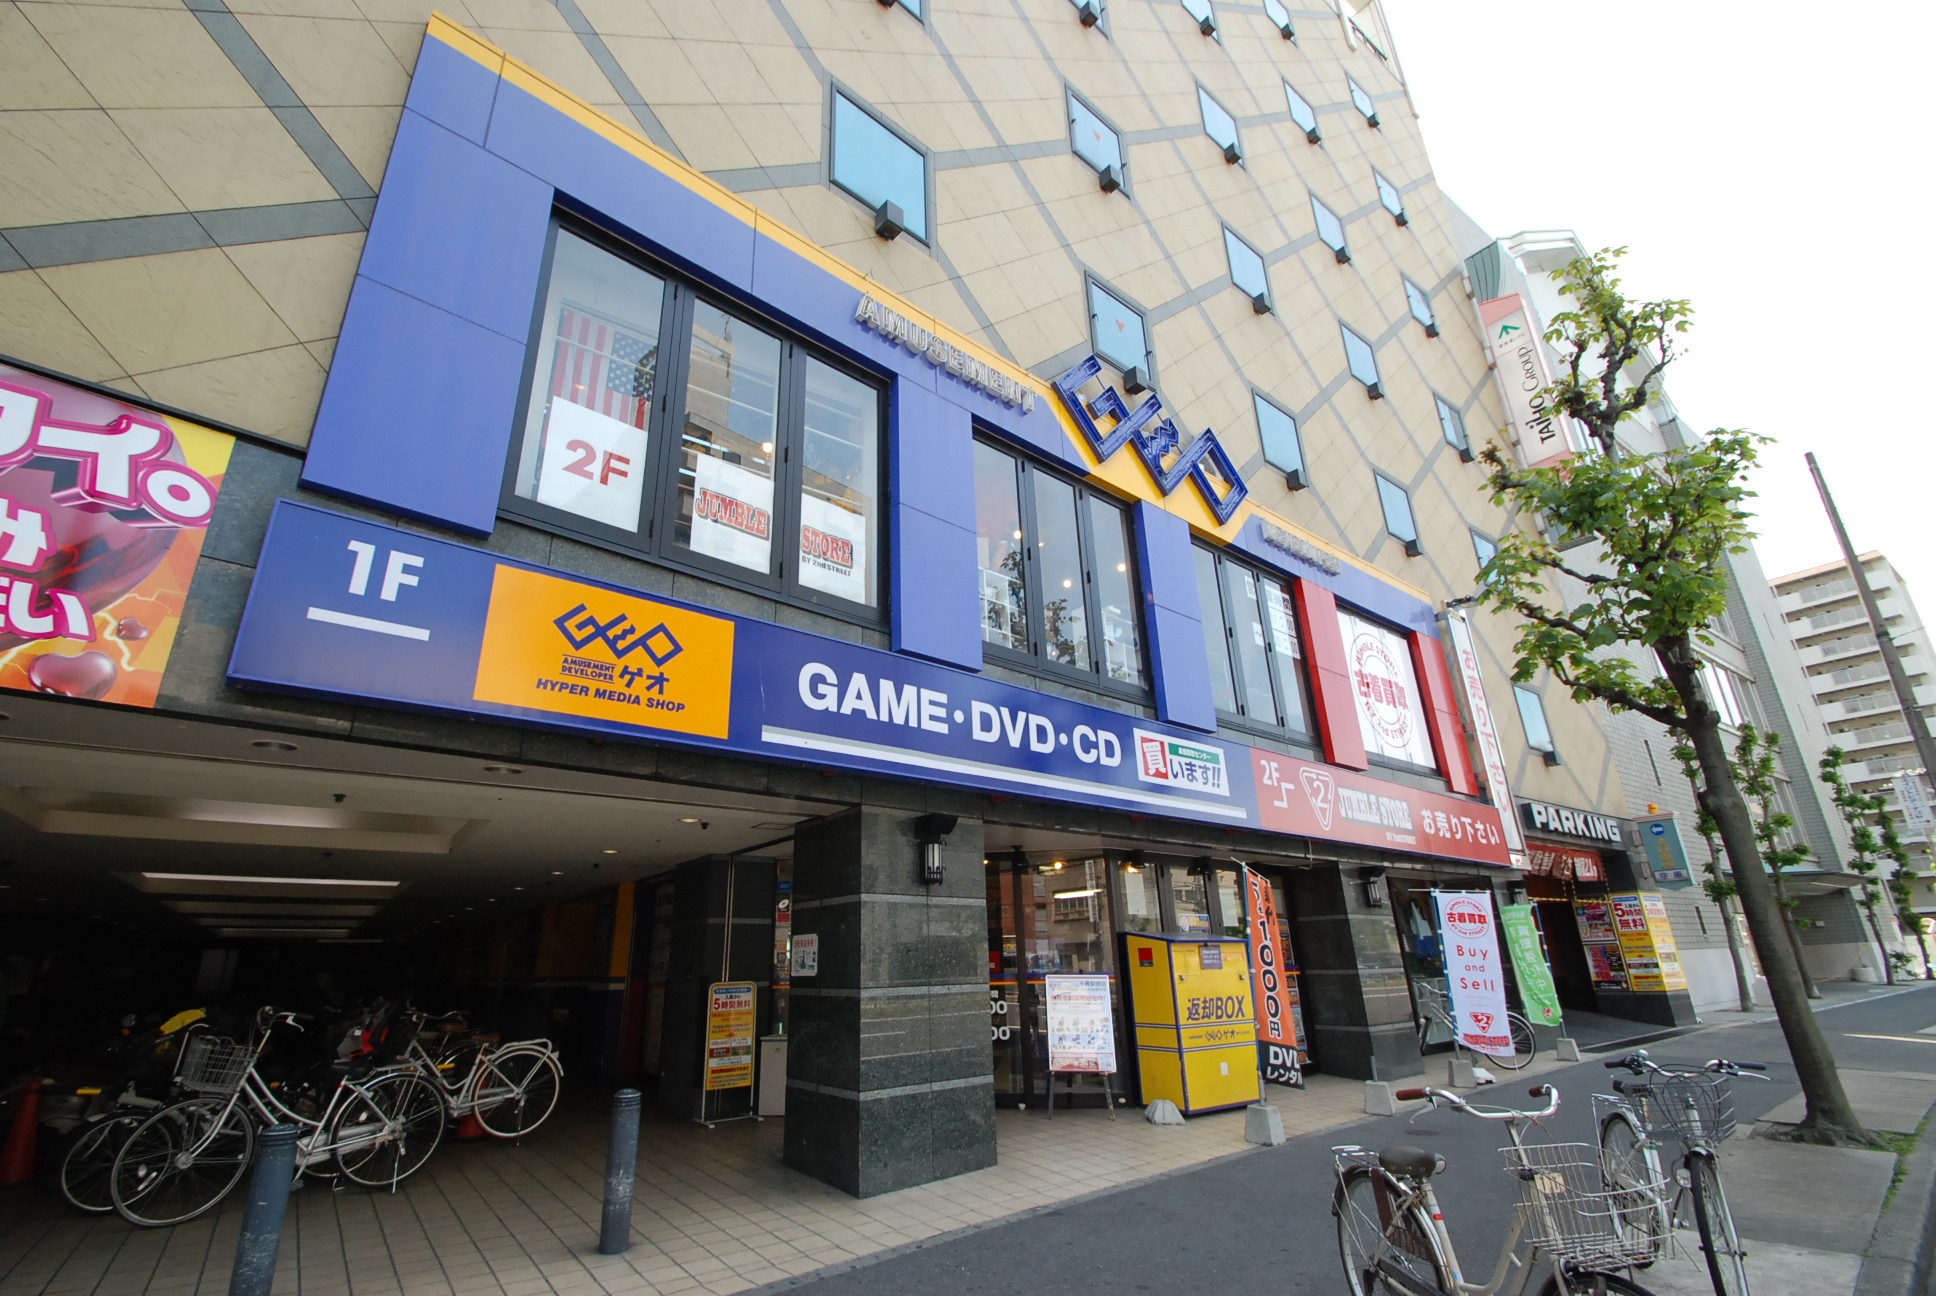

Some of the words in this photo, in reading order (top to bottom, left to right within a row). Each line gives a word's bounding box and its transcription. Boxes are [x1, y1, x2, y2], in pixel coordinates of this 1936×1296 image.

[855, 294, 1037, 413] AMUSEMENT
[562, 439, 630, 486] 2F
[695, 489, 769, 540] JUMBLE
[801, 525, 853, 568] STORE
[347, 540, 425, 602] 1F
[802, 556, 811, 565] BY
[827, 562, 851, 577] STREET
[0, 576, 90, 636] い
[561, 665, 614, 682] DEVELOPER
[562, 656, 616, 673] AMUSEMENT
[618, 665, 670, 695] ゲオ
[1354, 668, 1409, 712] 古着買取
[536, 678, 590, 697] HYPER
[594, 688, 641, 706] MEDIA
[646, 697, 685, 713] SHOP
[1260, 760, 1281, 787] 2F
[1313, 780, 1330, 808] 2
[1338, 787, 1380, 825] JUMBLE
[1379, 796, 1413, 830] STORE
[1421, 808, 1500, 845] お売り下さい
[1531, 803, 1621, 842] PARKING
[1446, 912, 1488, 925] 古着買取
[1618, 917, 1645, 930] 無料
[1456, 944, 1489, 961] Buy
[1464, 963, 1486, 972] and
[1460, 977, 1495, 992] Sell
[713, 997, 751, 1010] 5時間無料
[1186, 996, 1246, 1022] 返却BOX
[1223, 1029, 1236, 1039] ゲオ
[1478, 1015, 1489, 1027] 2
